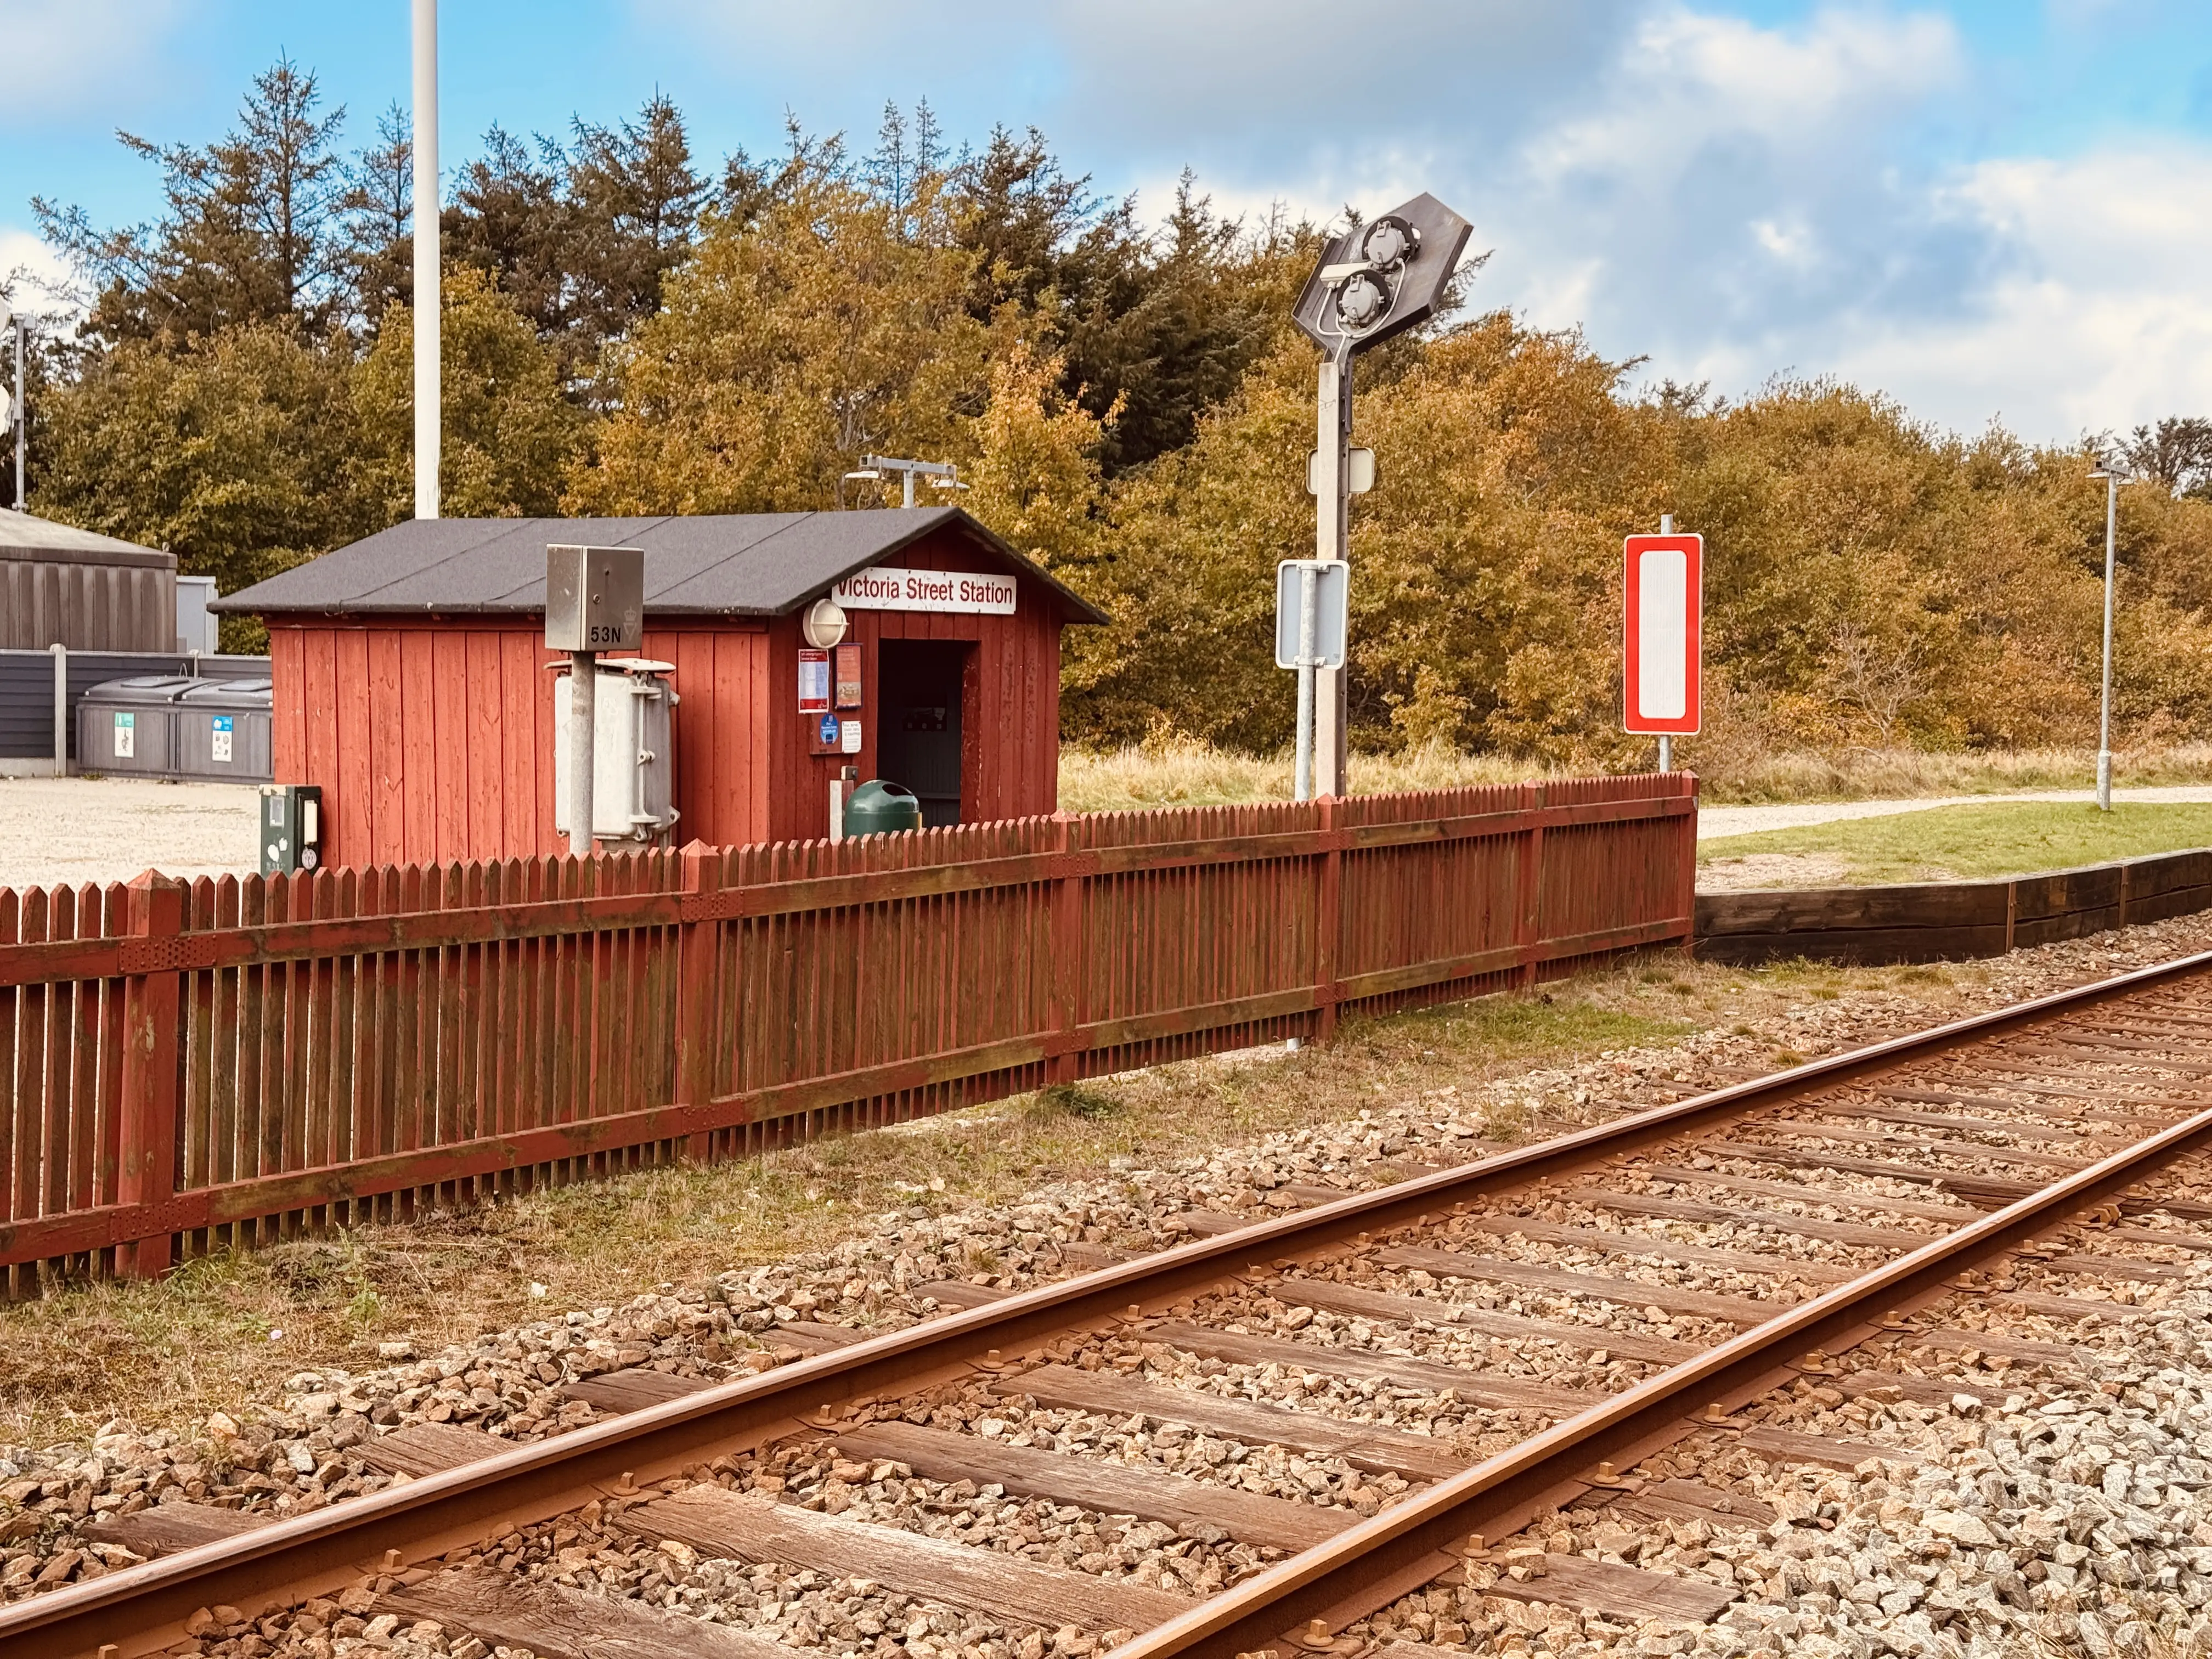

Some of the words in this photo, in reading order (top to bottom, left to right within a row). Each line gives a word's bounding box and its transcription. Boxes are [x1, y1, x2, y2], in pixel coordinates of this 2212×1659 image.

[838, 575, 899, 599] Victoria
[906, 577, 954, 601] Street
[960, 580, 1013, 605] Station
[591, 626, 621, 643] 53N
